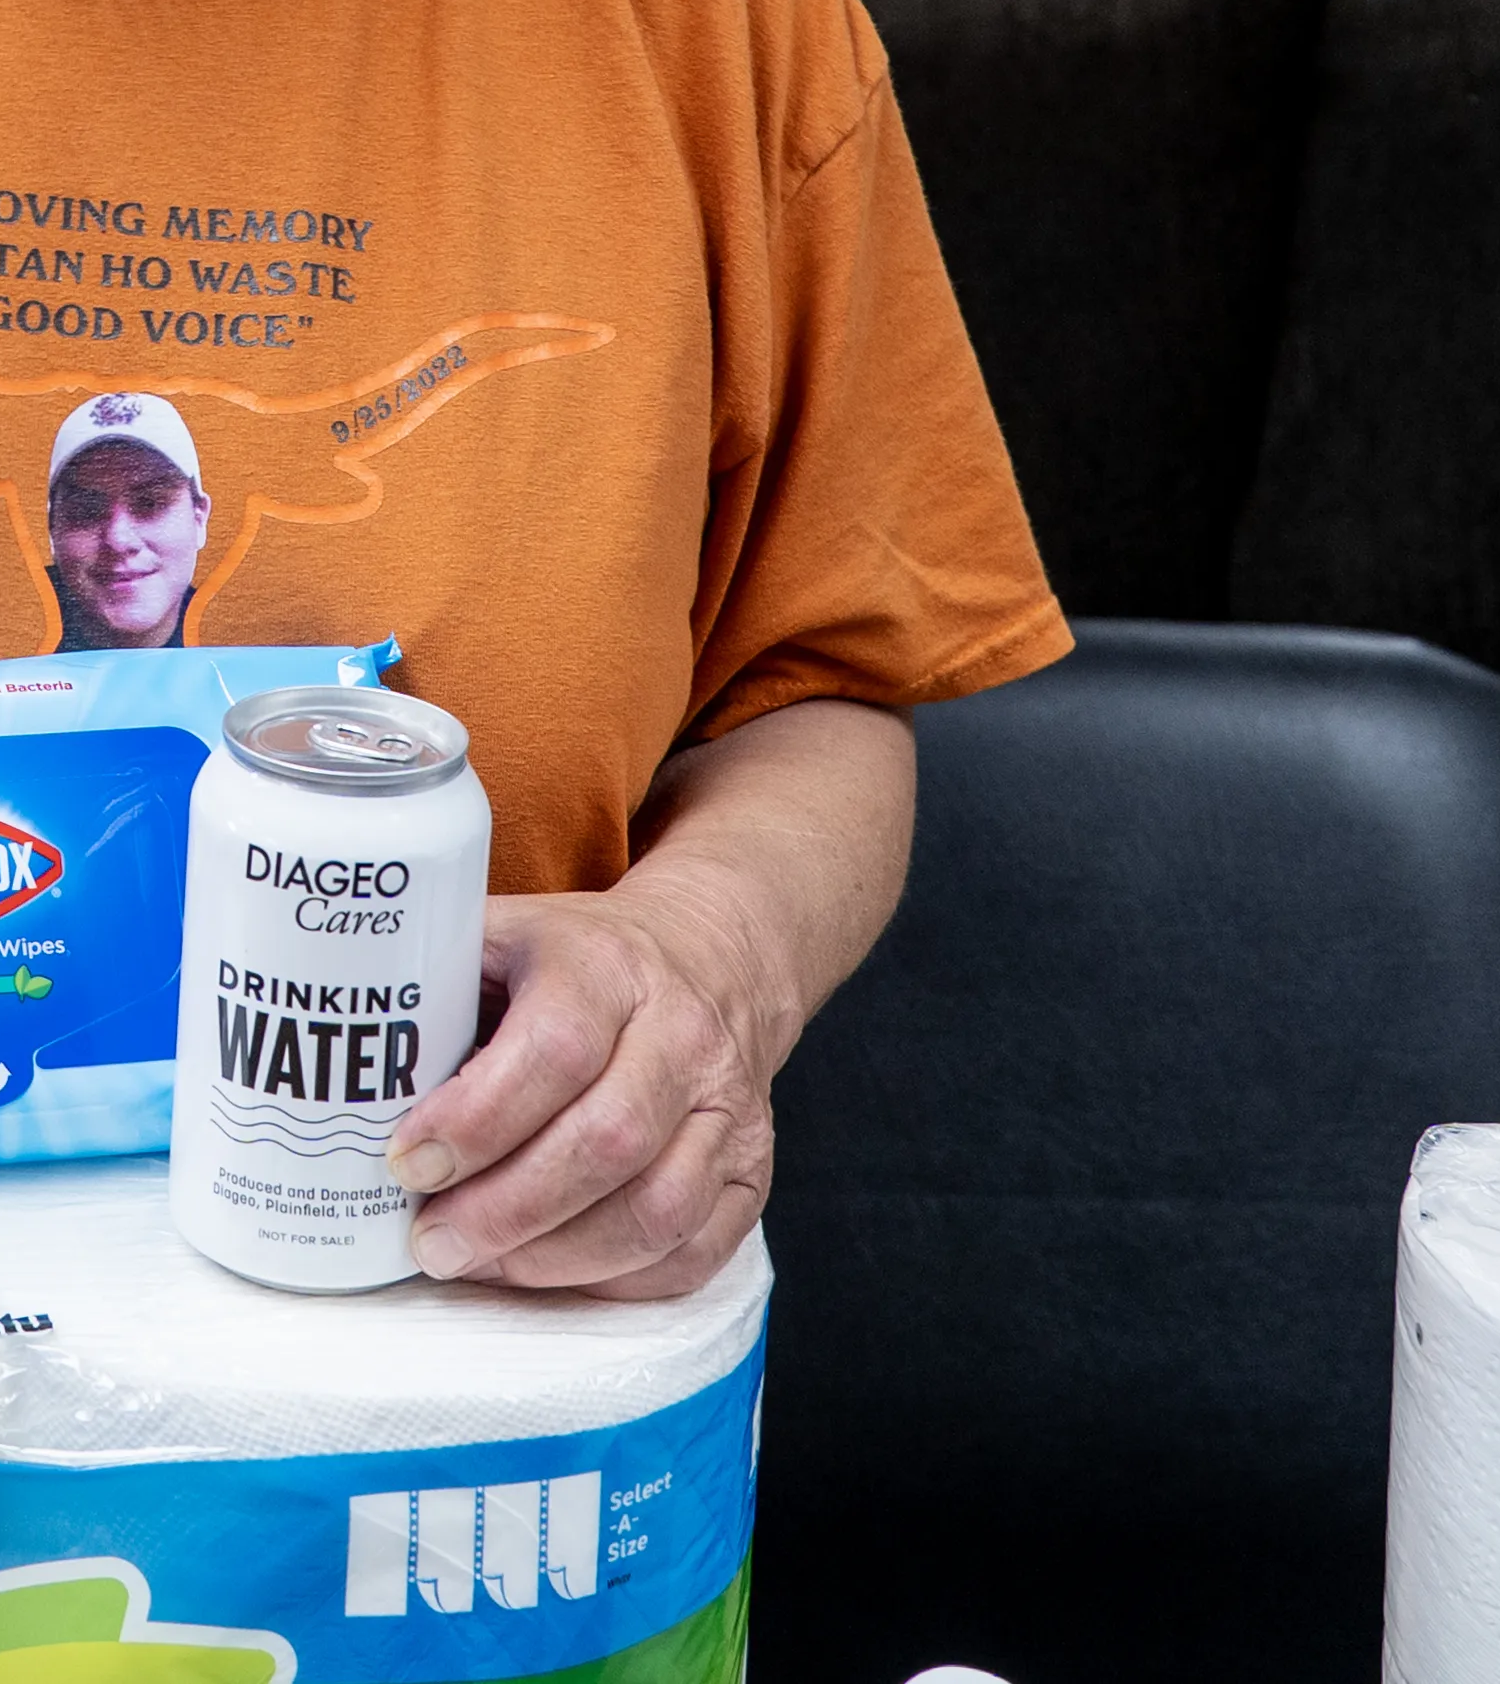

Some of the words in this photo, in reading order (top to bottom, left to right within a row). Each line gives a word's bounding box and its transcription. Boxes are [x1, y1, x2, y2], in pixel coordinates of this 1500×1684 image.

[163, 206, 374, 252] MEMORY
[101, 254, 172, 290] HO
[189, 259, 357, 304] WASTE
[331, 345, 467, 444] 9/25/2022
[6, 680, 73, 693] Bacteria
[246, 843, 410, 898] DIAGEO
[295, 897, 404, 935] Cares
[218, 958, 421, 1014] DRINKING
[217, 994, 420, 1103] WATER
[213, 1182, 260, 1210] Diageo,
[265, 1199, 340, 1219] Plainfield,
[346, 1206, 358, 1217] IL
[362, 1199, 408, 1217] 60544
[219, 1167, 282, 1196] Produced
[288, 1187, 315, 1201] and
[321, 1186, 382, 1202] Donated
[387, 1184, 402, 1198] by
[258, 1228, 287, 1242] (NOT
[291, 1234, 316, 1245] FOR
[320, 1235, 355, 1246] SALE)
[609, 1471, 673, 1511] Select
[609, 1514, 639, 1535] -A-
[608, 1534, 648, 1563] Size
